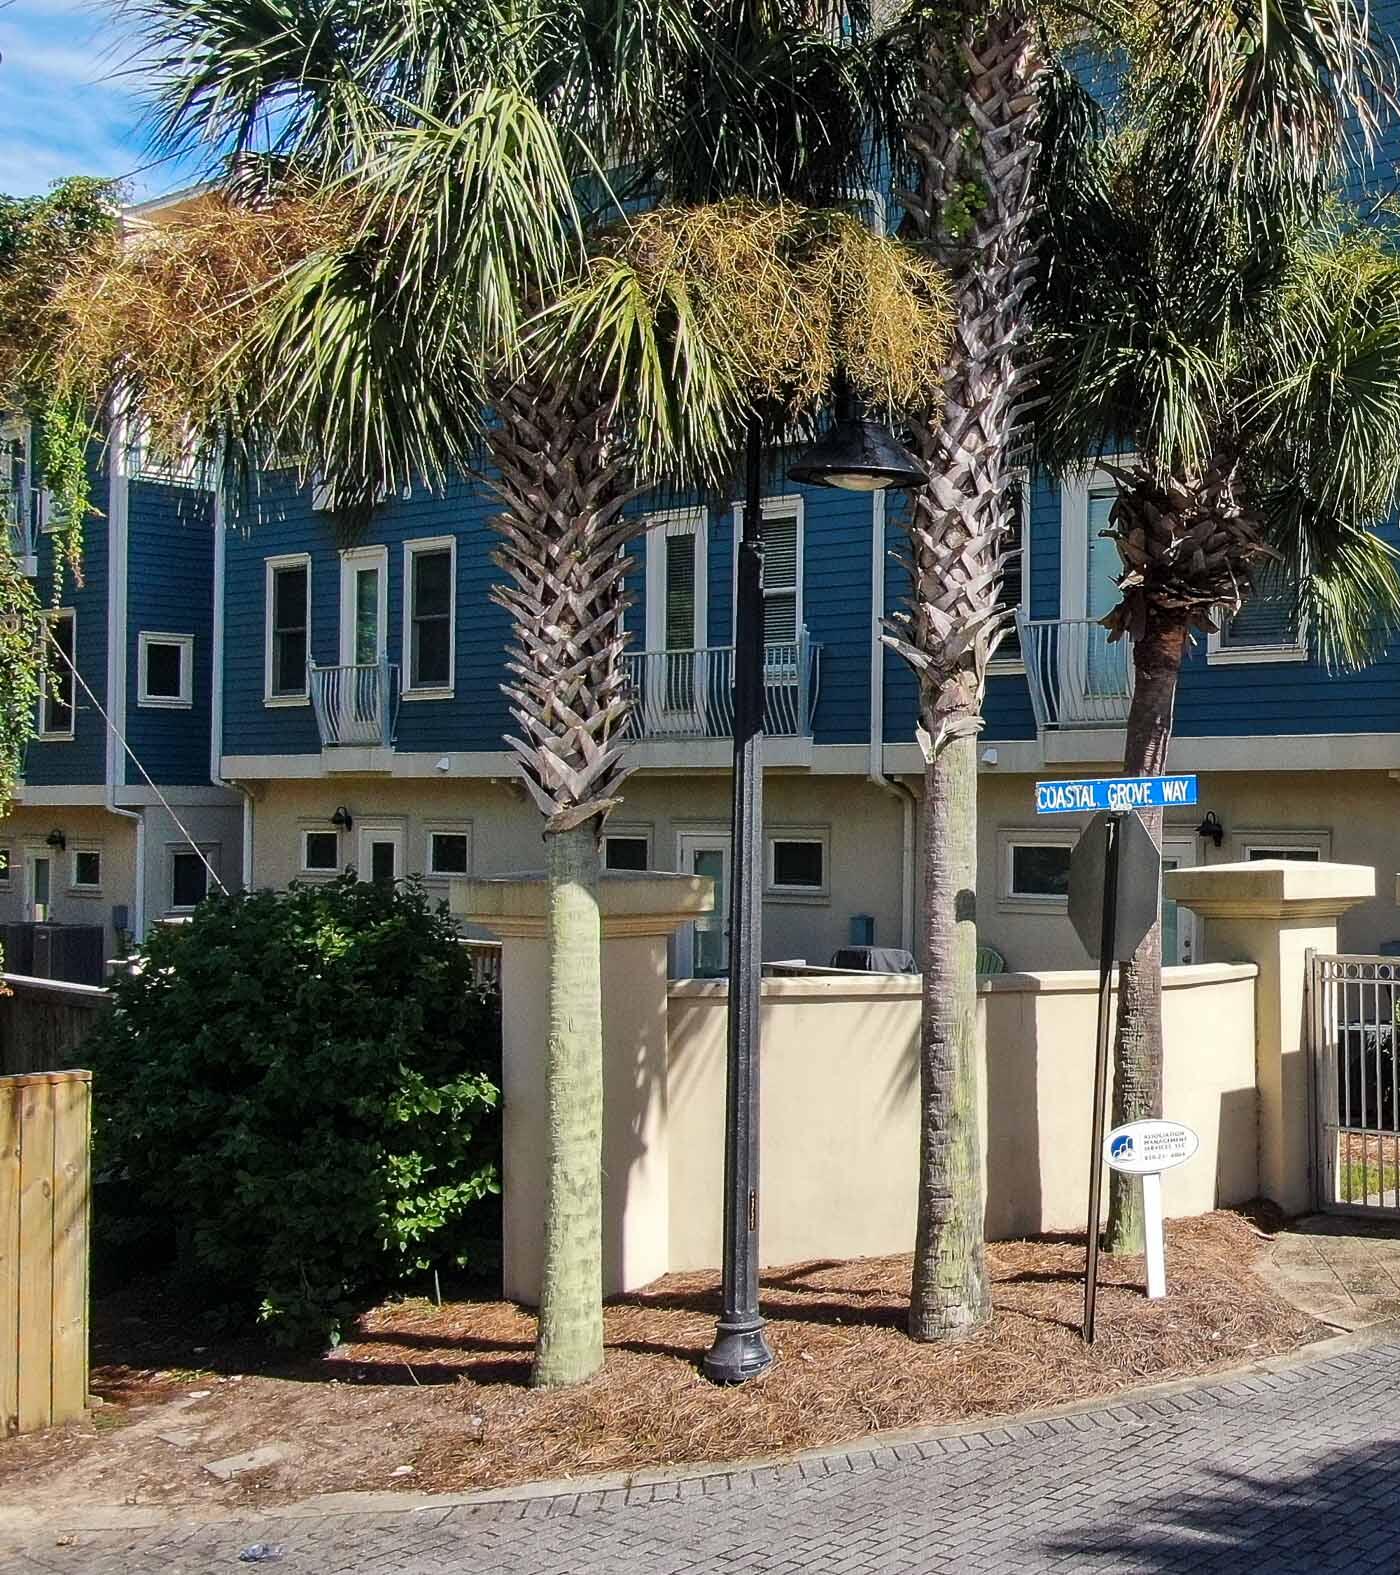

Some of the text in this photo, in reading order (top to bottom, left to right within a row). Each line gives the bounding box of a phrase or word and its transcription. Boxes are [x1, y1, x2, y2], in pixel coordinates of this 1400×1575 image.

[1038, 781, 1189, 809] COASTAL GROVE WAY
